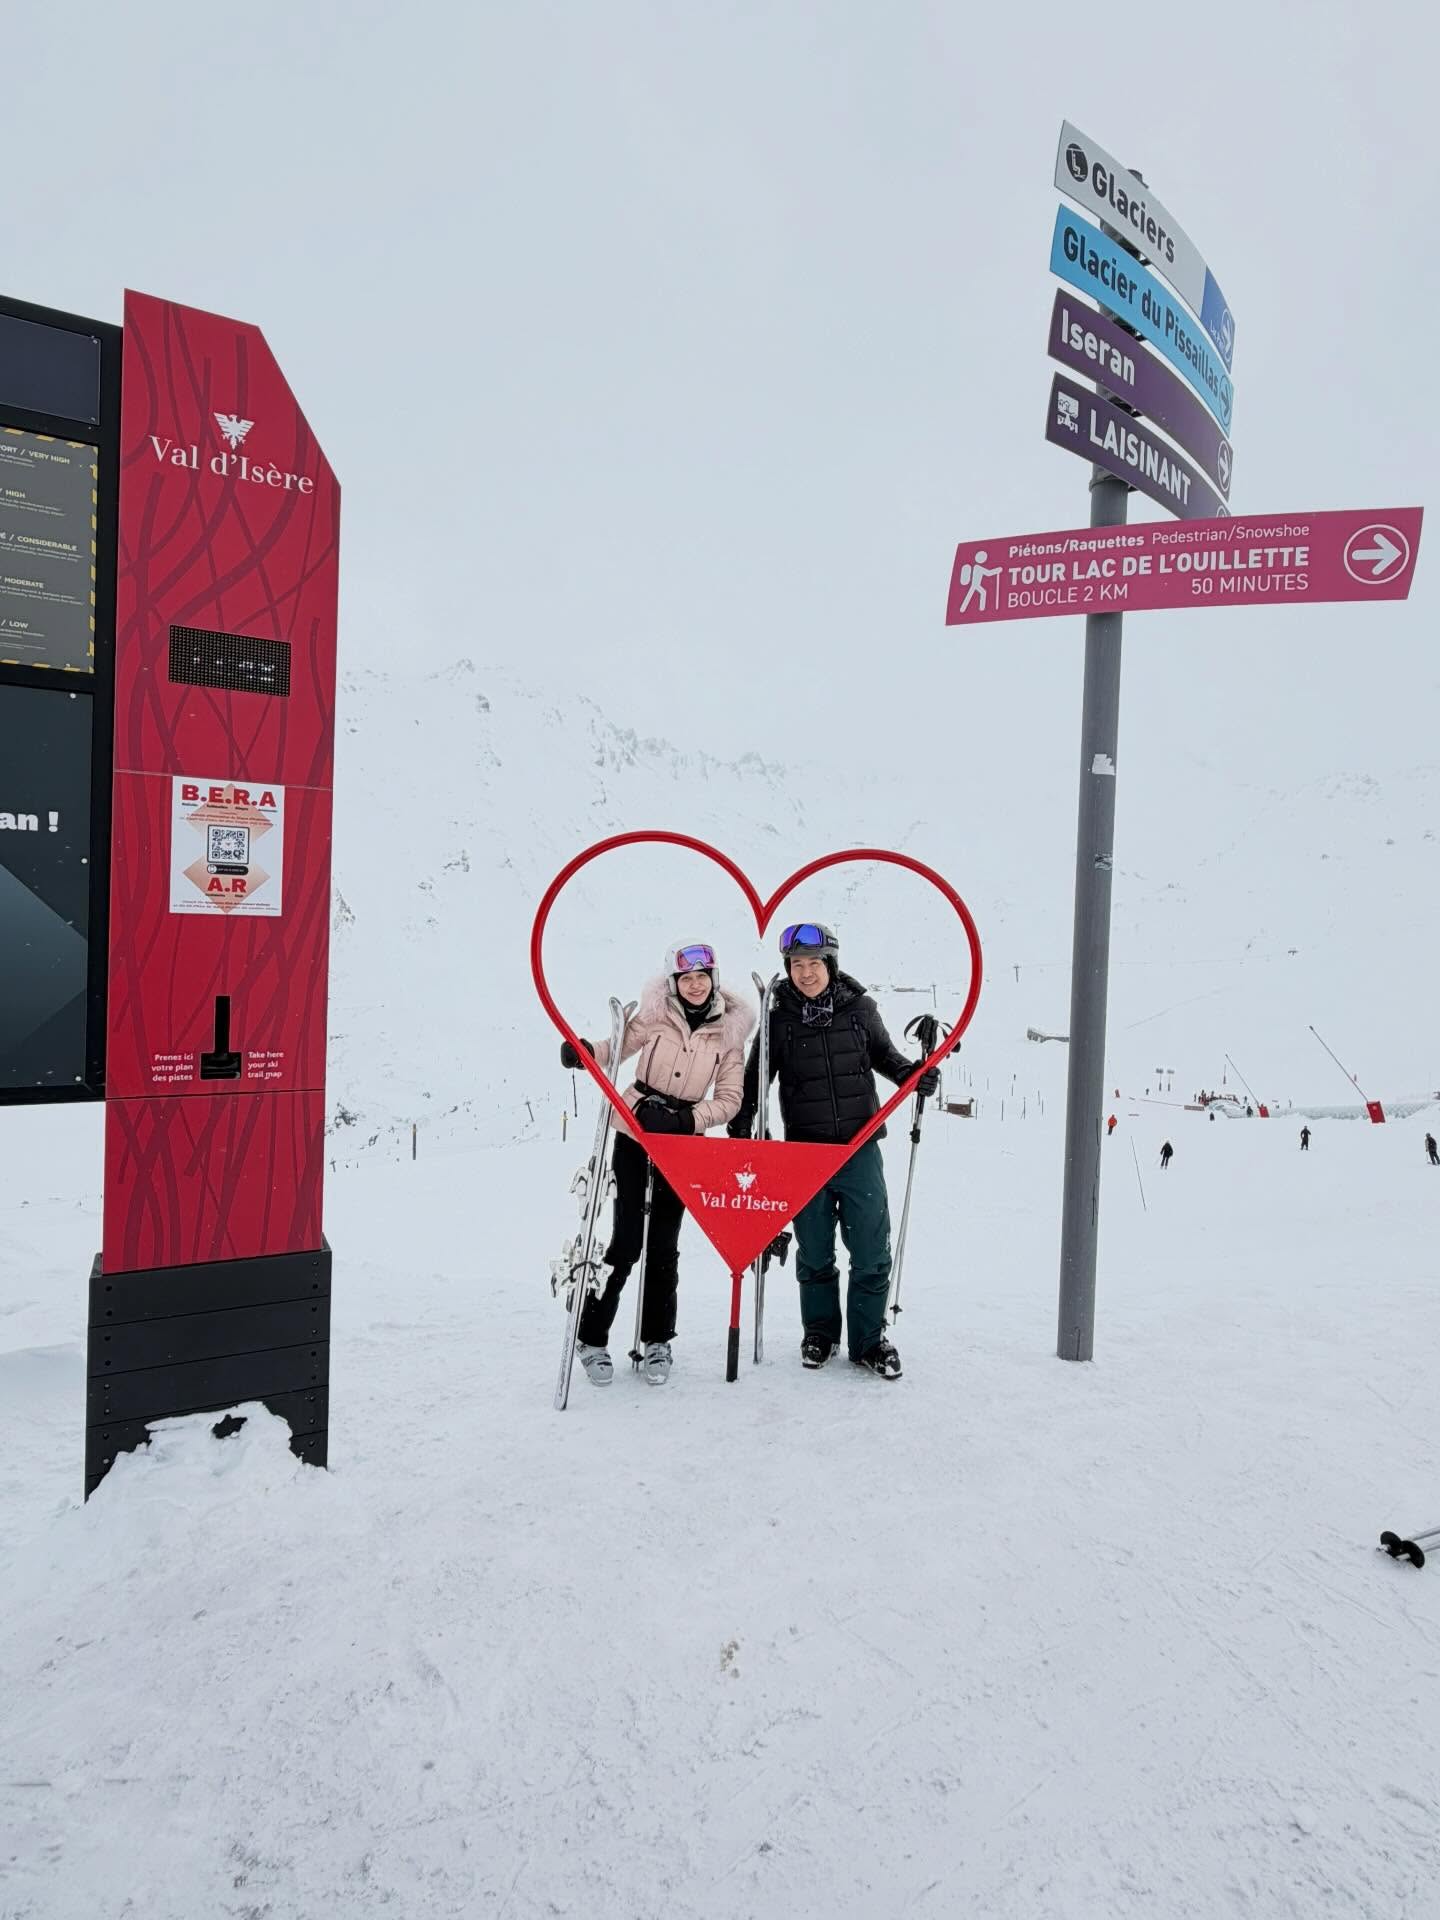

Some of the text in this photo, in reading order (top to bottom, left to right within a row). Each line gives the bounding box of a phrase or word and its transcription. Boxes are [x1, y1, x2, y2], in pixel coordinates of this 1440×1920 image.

[1092, 162, 1174, 263] Glaciers
[1063, 226, 1138, 304] Glacier
[1141, 288, 1161, 329] du
[1164, 306, 1219, 399] Pissaillas
[1061, 308, 1136, 386] Iseran
[0, 444, 18, 454] ORT
[28, 450, 50, 460] VERY
[50, 455, 70, 464] HIGH
[1089, 408, 1191, 506] LAISINANT
[149, 435, 314, 494] Val d’Isère
[5, 489, 26, 498] HIGH
[17, 535, 78, 551] CONSIDERABLE
[1009, 524, 1310, 558] Piétons/Raquettes Pedestrian/Snowshoe
[1008, 546, 1310, 586] TOUR LAC DE L’OUILLETTE
[4, 576, 44, 589] MODERATE
[1191, 573, 1309, 595] 50 MINUTES
[1008, 583, 1128, 608] BOUCLE 2 KM
[9, 620, 29, 629] LOW
[182, 784, 276, 807] B.E.R.A
[48, 811, 59, 832] !
[207, 877, 247, 893] A.R
[183, 1053, 194, 1061] ici
[247, 1051, 284, 1059] Take here
[247, 1060, 279, 1070] your ski
[151, 1063, 194, 1073] votre plan
[152, 1073, 193, 1083] des pistes
[247, 1070, 282, 1080] trail map
[700, 1191, 788, 1212] Val d’Isère
